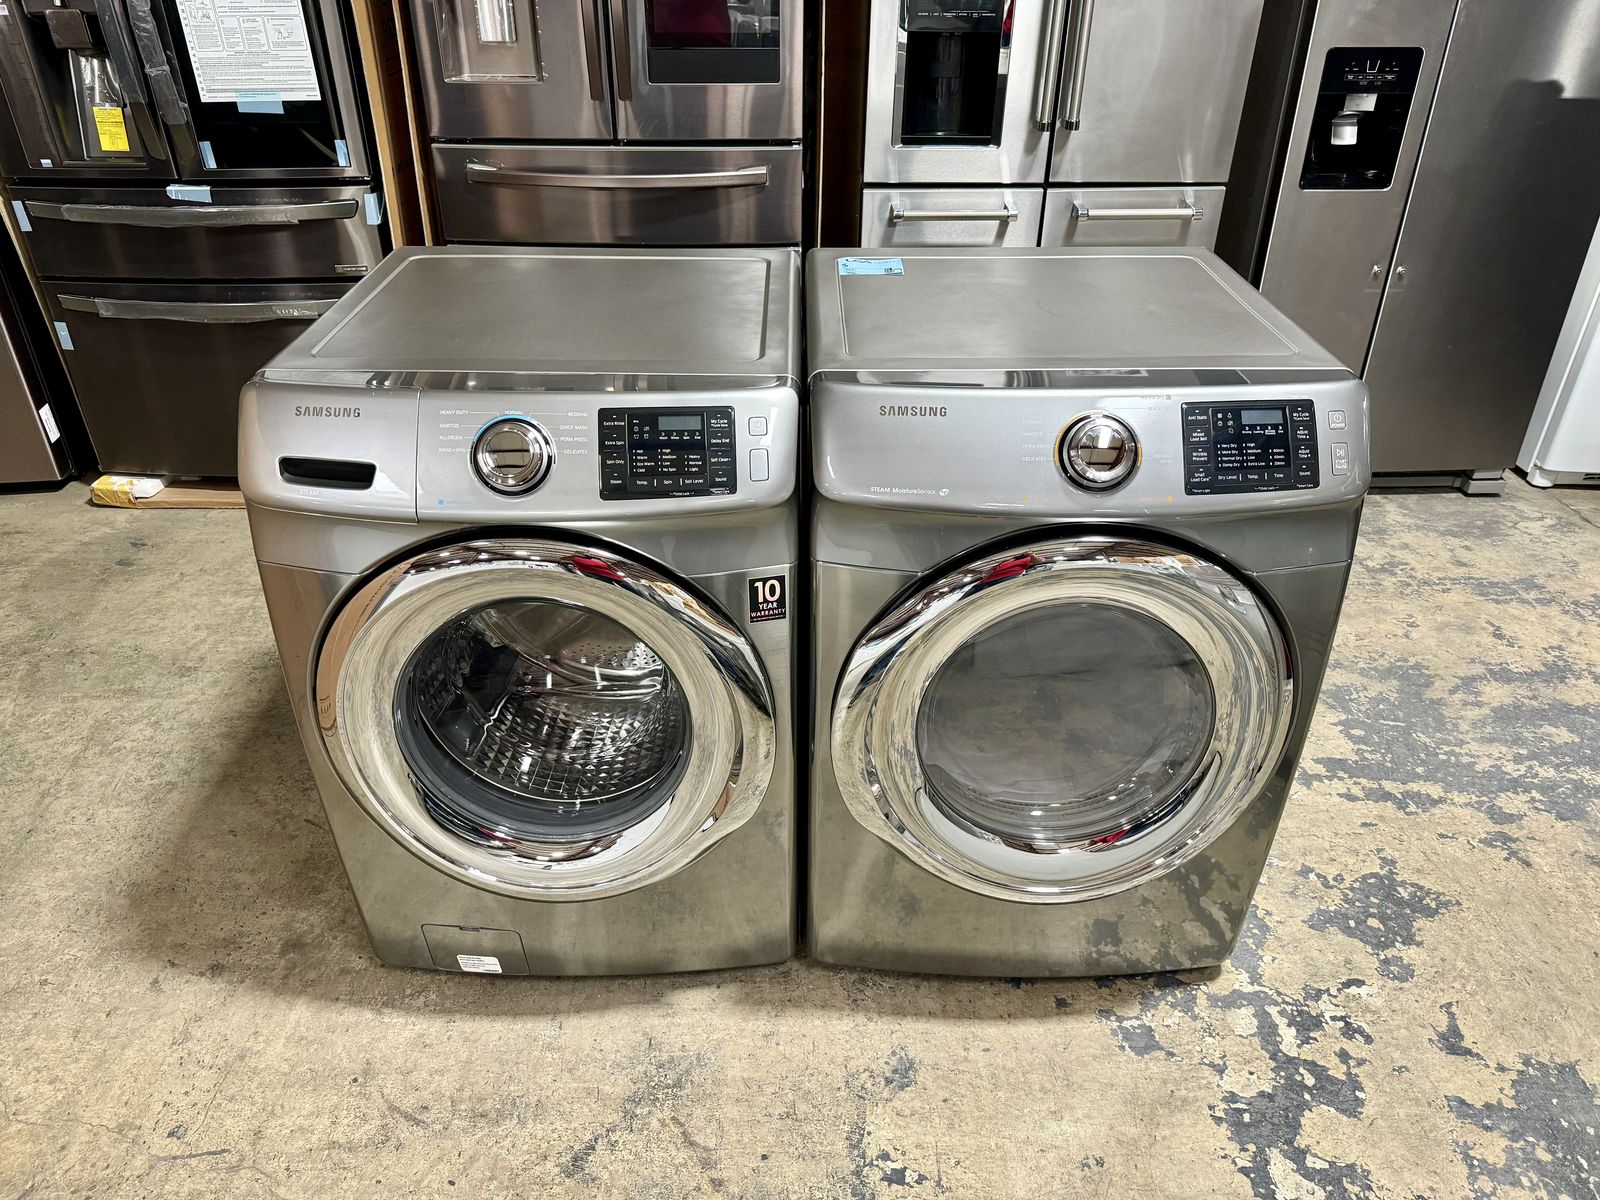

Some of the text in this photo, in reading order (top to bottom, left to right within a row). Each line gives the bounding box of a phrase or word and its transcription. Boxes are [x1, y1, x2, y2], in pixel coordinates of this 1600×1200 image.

[295, 406, 360, 417] SAMSUNG
[880, 405, 947, 417] SAMSUNG
[754, 579, 781, 602] 10
[750, 608, 786, 618] WARRANTY
